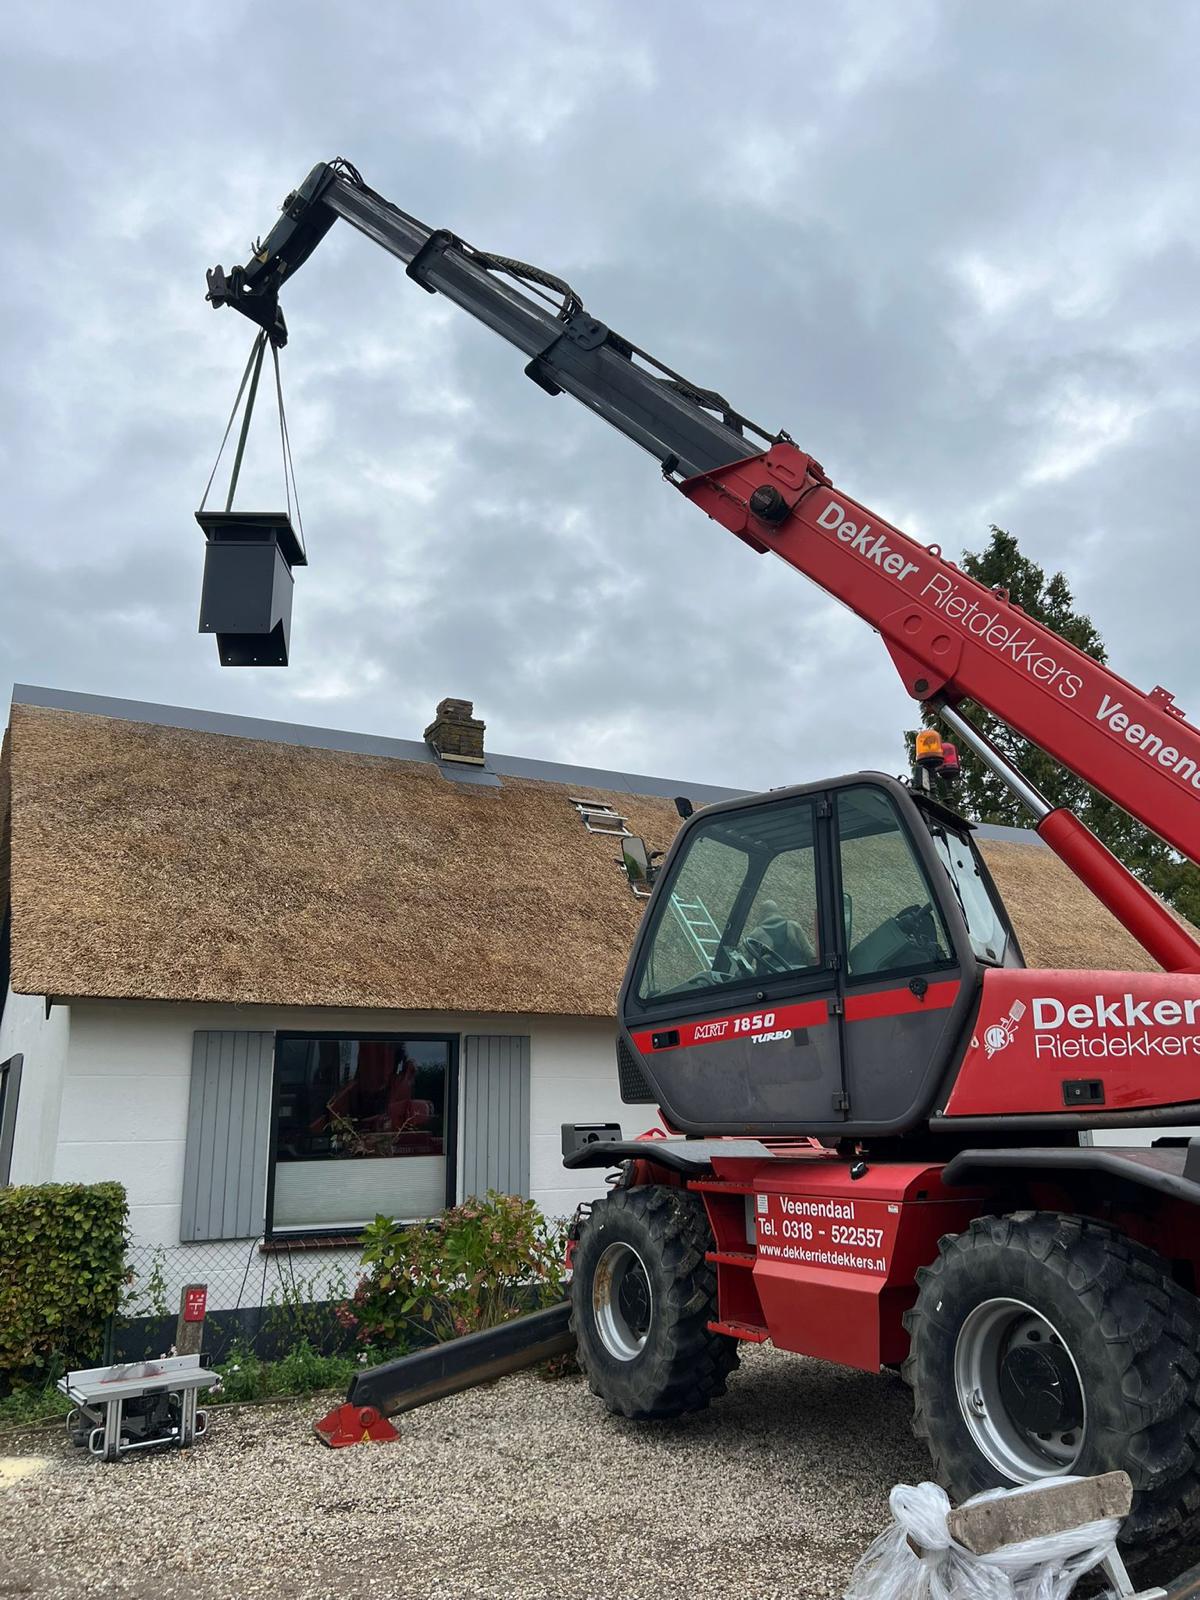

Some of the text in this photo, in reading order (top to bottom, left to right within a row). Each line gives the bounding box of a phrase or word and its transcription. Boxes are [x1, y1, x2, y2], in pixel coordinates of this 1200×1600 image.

[816, 501, 919, 581] Dekker
[919, 572, 1083, 699] Rietdekkers
[1032, 994, 1200, 1029] Dekker
[694, 1013, 775, 1039] MRT 1850
[751, 1029, 791, 1043] TURBO
[780, 1196, 854, 1219] Veenendaal
[758, 1218, 777, 1236] Tel.
[782, 1220, 813, 1240] 0318
[831, 1225, 884, 1248] 522557
[759, 1244, 886, 1271] www.dekkerrietdekkers.nl
